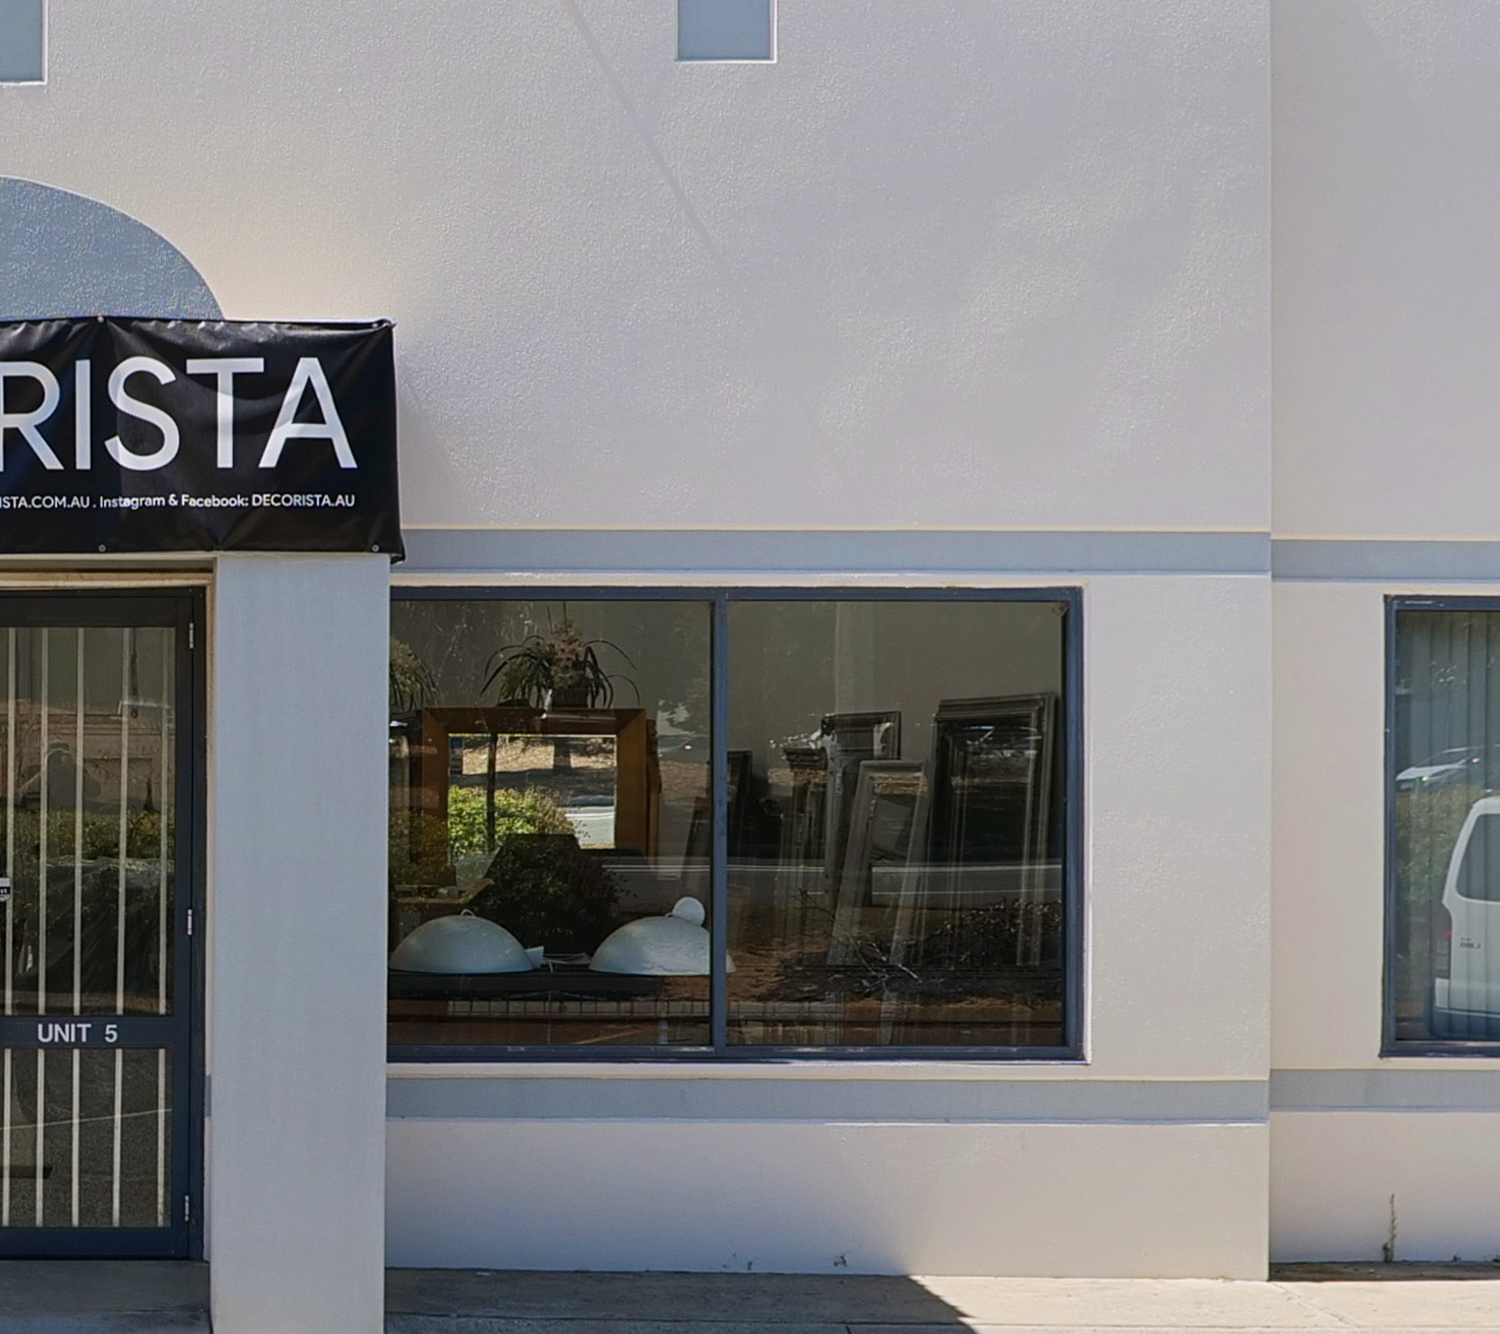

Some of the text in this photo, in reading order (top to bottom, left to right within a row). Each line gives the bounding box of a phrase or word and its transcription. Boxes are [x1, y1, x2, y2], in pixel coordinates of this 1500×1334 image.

[100, 495, 166, 511] Instagram
[168, 494, 179, 507] &
[182, 494, 249, 507] Facebook:
[252, 493, 356, 507] DECORISTA.AU
[37, 1023, 118, 1043] UNIT 5
